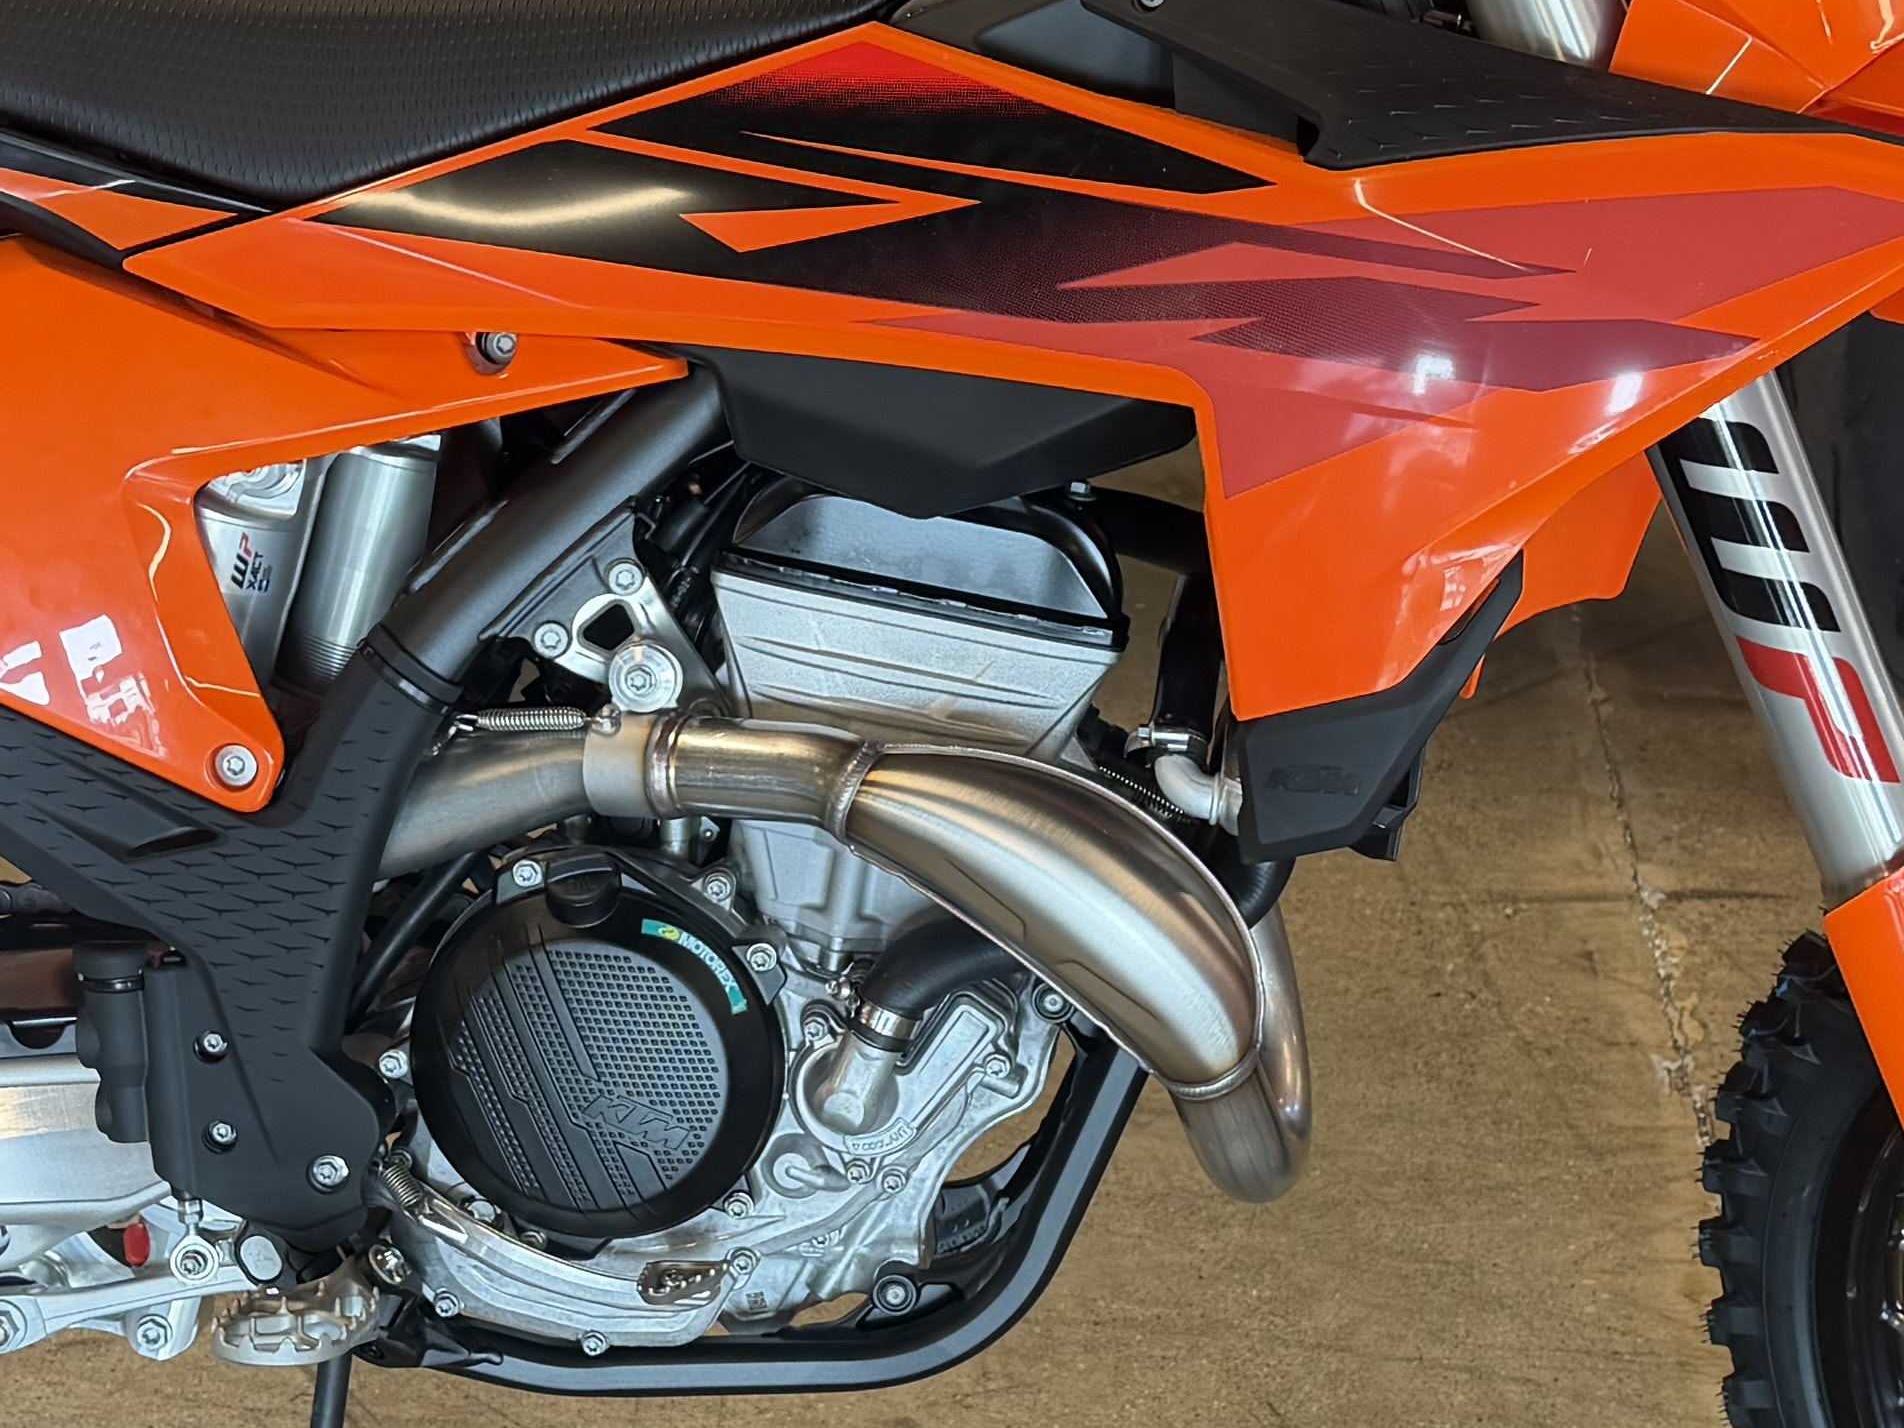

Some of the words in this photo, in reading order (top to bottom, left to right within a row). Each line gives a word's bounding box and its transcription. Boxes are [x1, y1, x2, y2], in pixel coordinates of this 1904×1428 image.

[245, 550, 265, 591] XACT
[677, 930, 738, 995] MOTOREX
[582, 1094, 692, 1151] KTM
